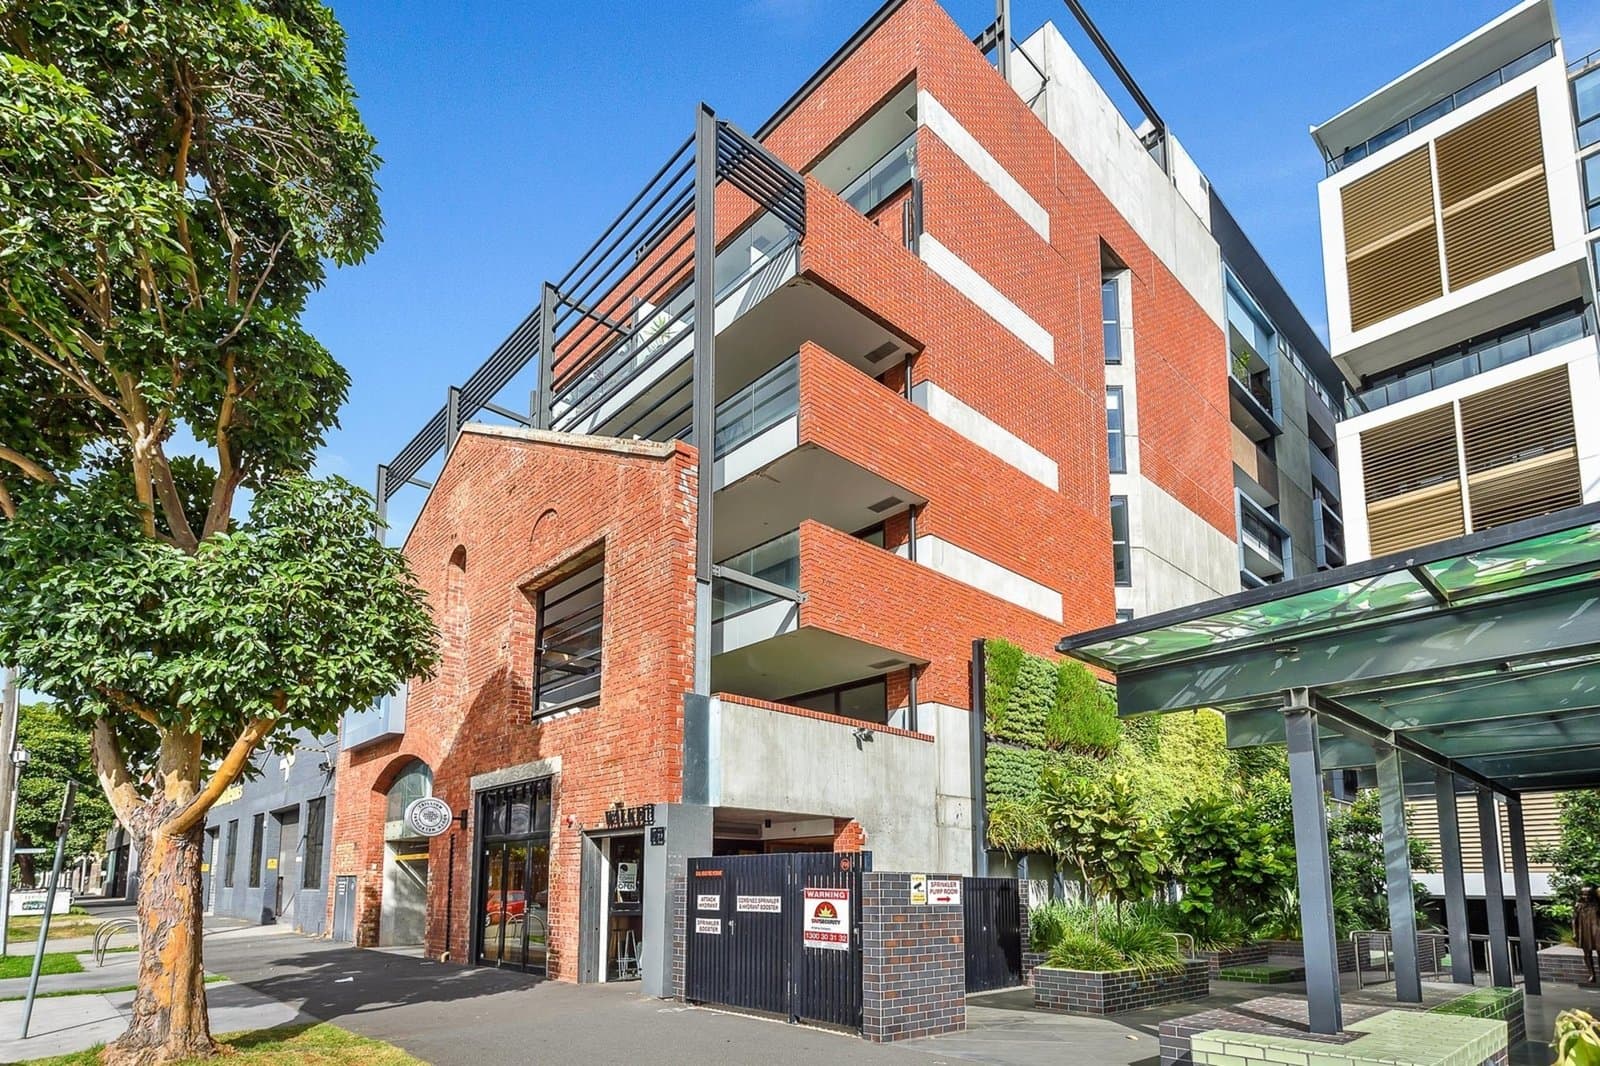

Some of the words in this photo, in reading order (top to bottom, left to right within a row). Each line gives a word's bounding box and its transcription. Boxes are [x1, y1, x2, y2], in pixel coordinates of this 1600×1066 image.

[806, 890, 846, 899] WARNING
[806, 932, 820, 940] 1300
[820, 933, 829, 941] 30
